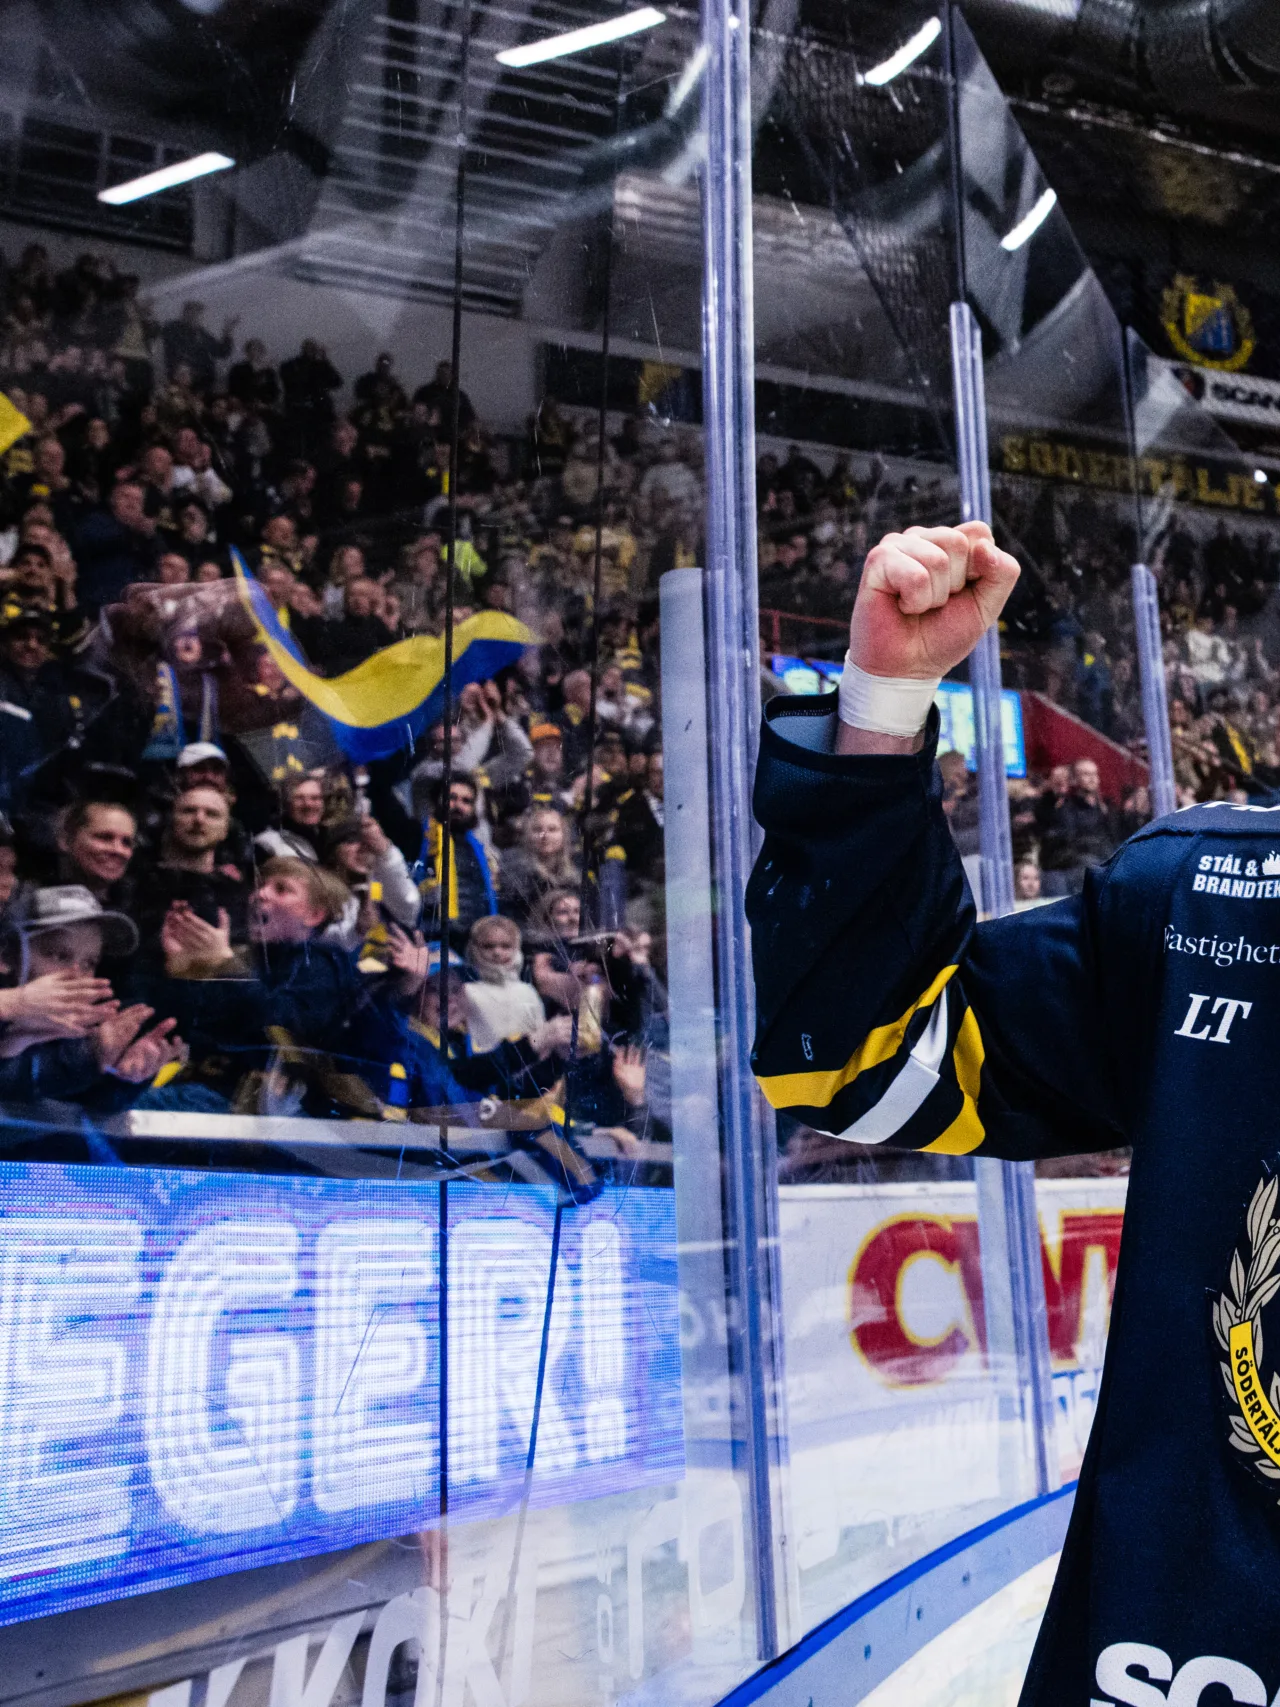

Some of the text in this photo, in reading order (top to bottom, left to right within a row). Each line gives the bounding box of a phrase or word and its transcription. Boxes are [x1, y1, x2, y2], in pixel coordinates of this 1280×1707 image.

[1198, 854, 1258, 877] STÅL &
[1174, 993, 1253, 1044] LT
